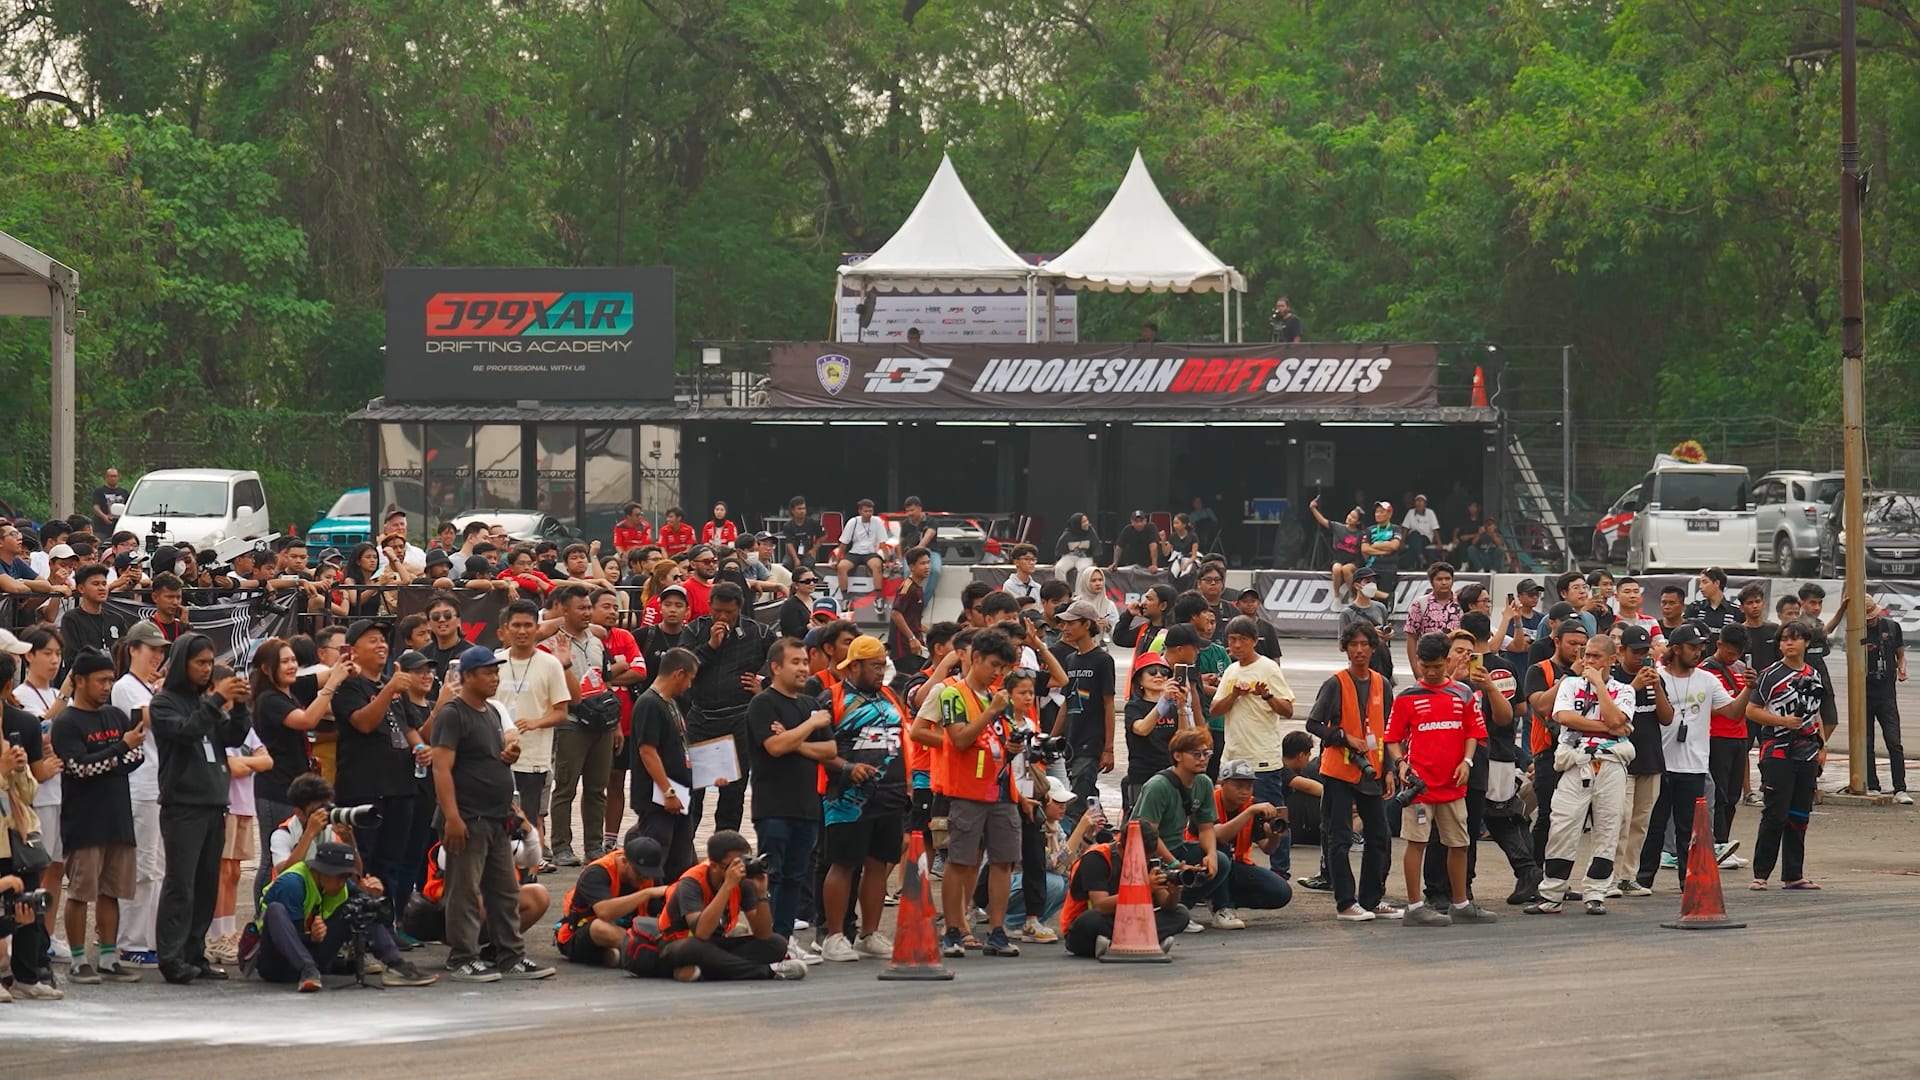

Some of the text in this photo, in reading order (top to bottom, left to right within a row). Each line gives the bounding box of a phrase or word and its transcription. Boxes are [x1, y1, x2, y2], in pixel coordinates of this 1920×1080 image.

[434, 300, 625, 330] J99XAR
[425, 341, 633, 353] DRIFTING ACADEMY
[971, 358, 1392, 393] INDONESIAN DRIFT SERIES
